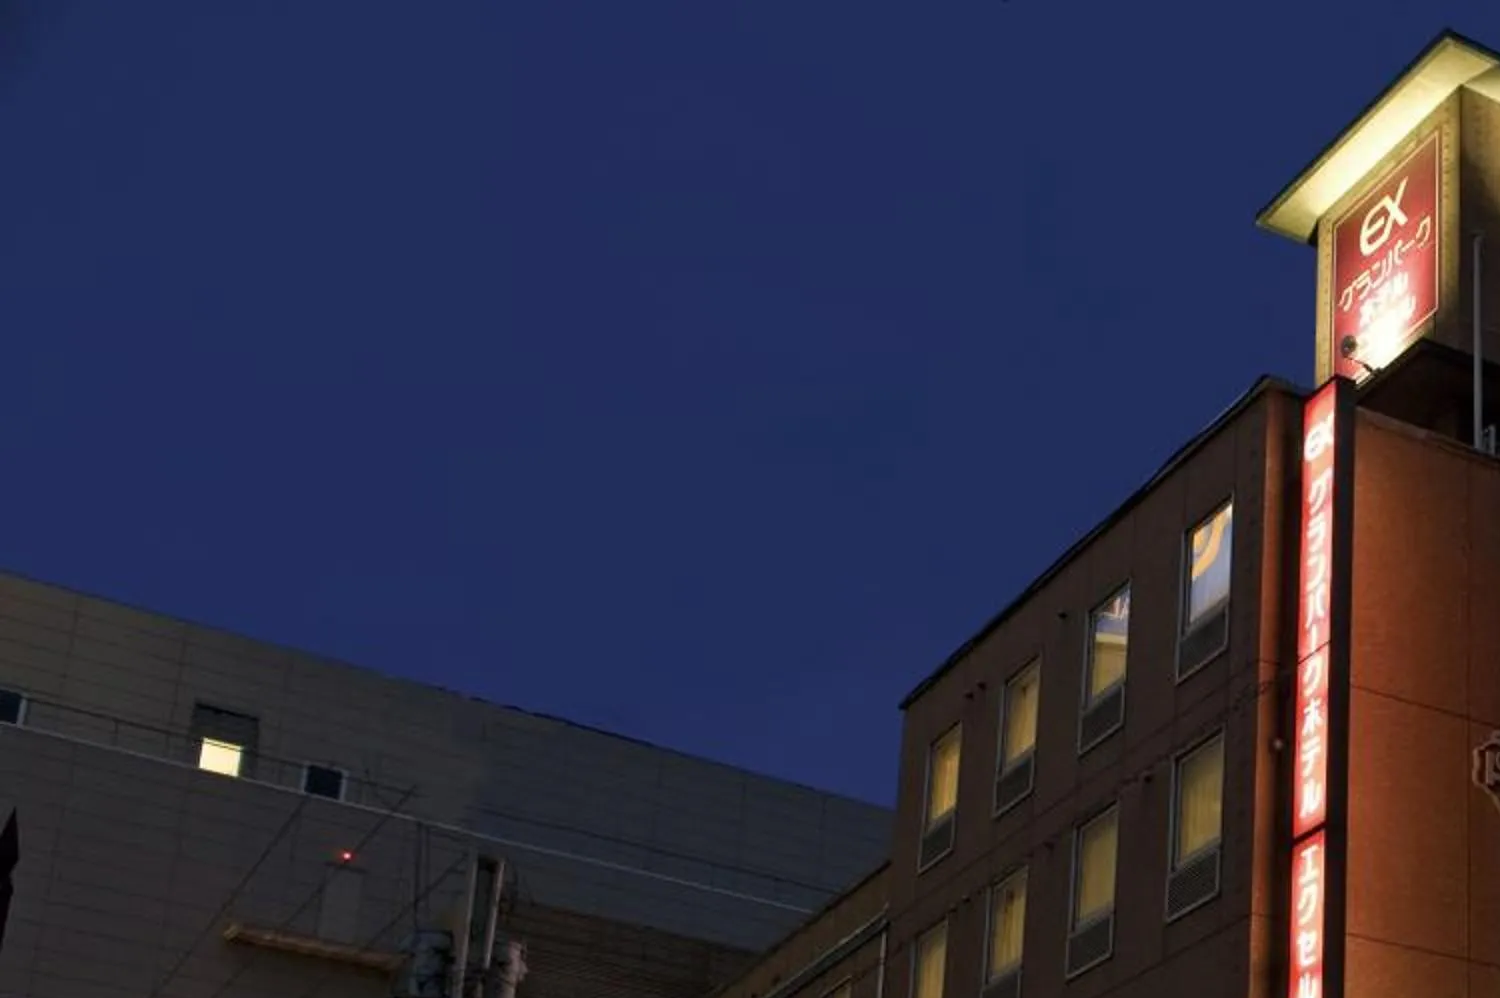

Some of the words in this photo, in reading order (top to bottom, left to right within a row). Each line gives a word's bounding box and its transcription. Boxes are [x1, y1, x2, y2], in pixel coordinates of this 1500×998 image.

[1338, 214, 1431, 312] グランパーク
